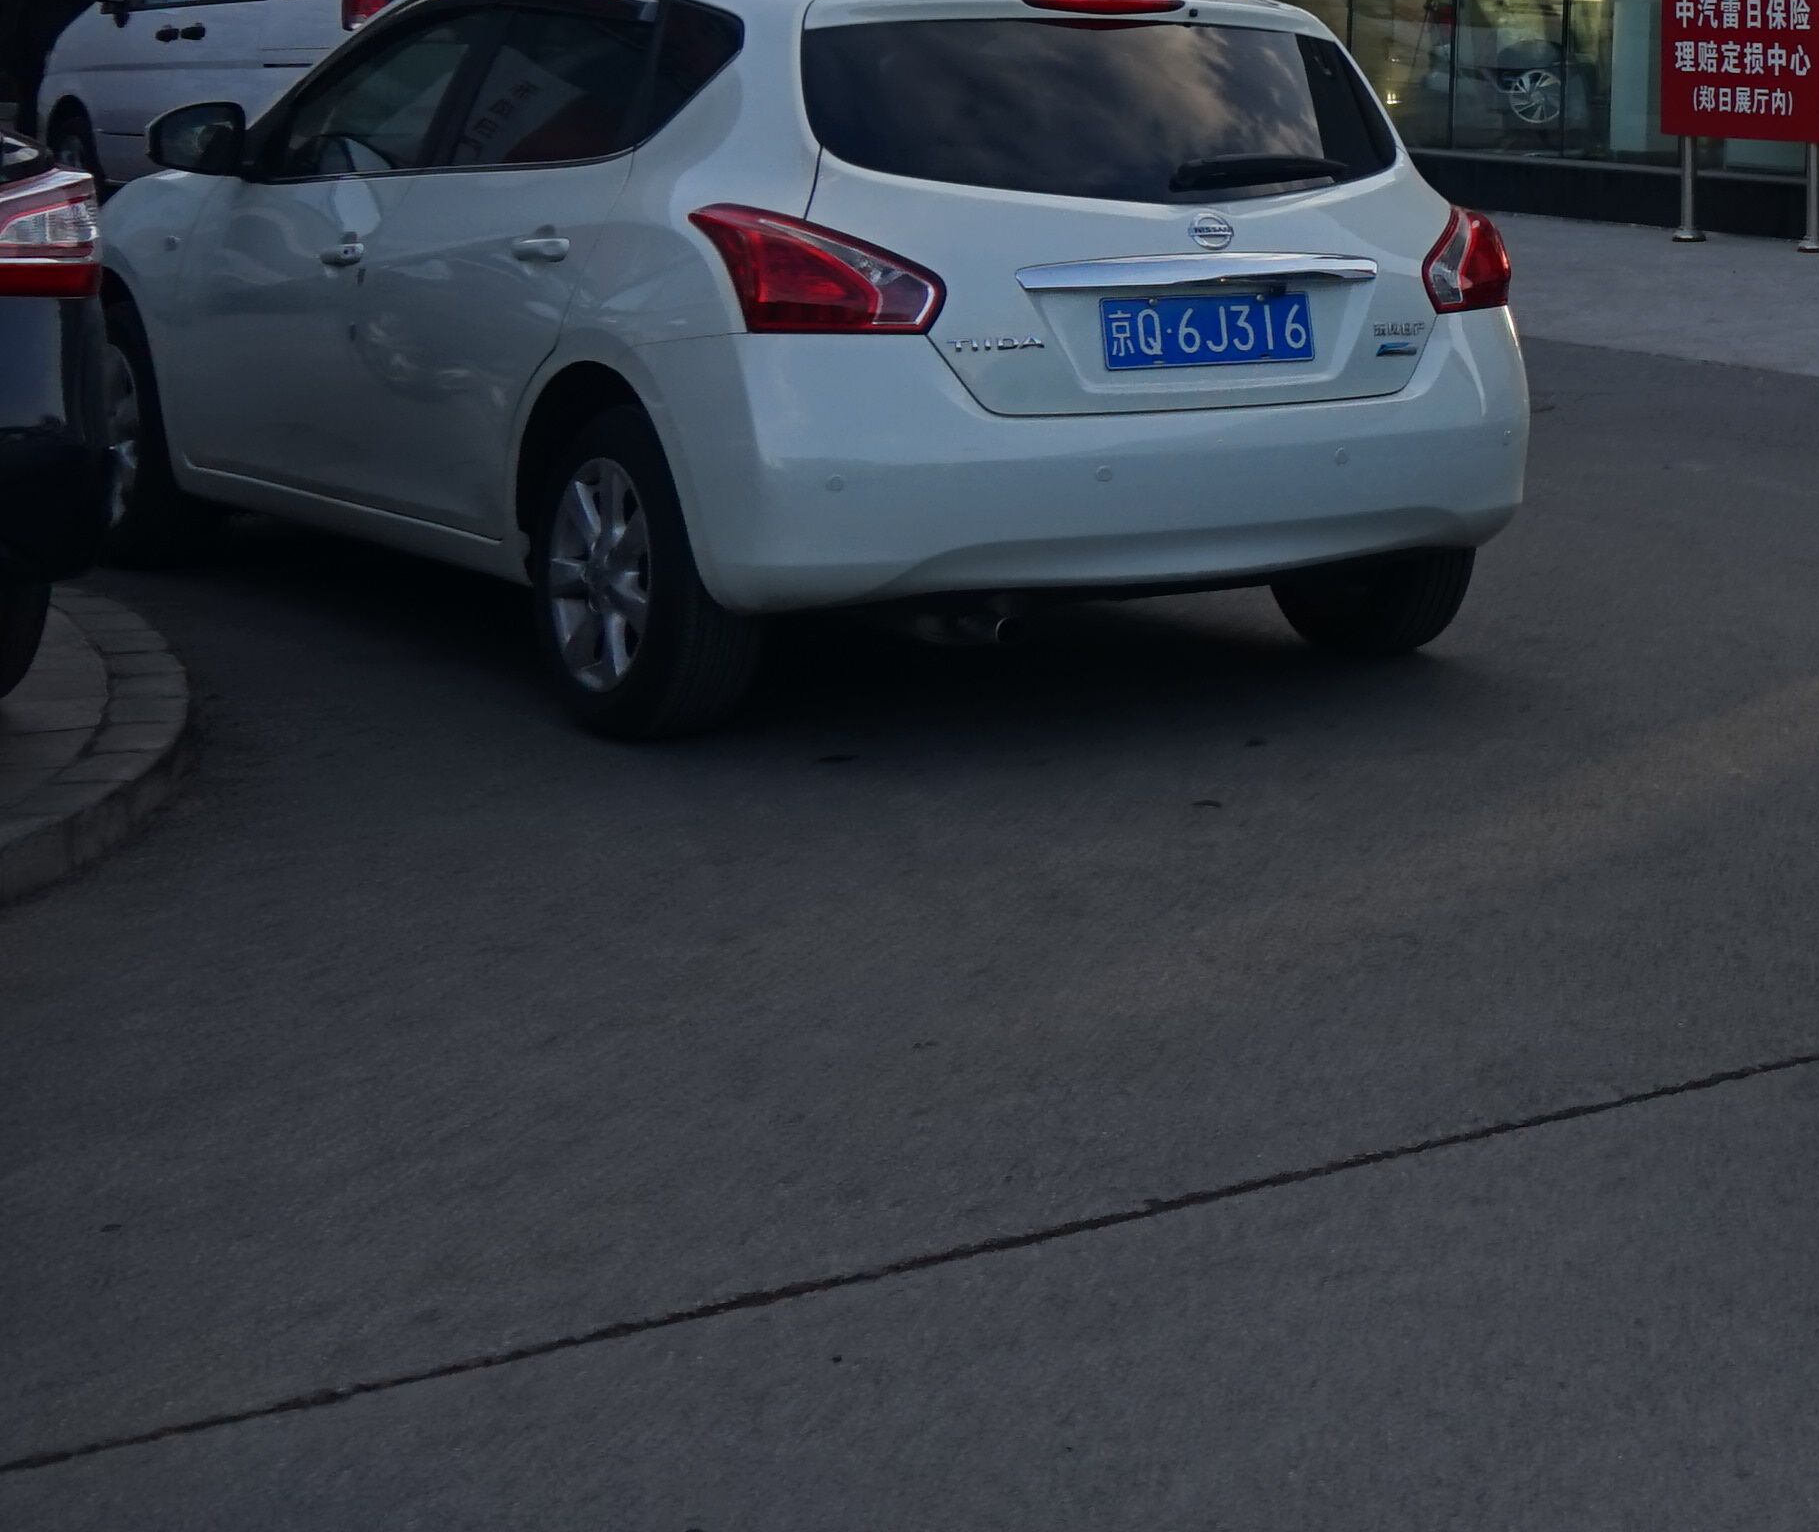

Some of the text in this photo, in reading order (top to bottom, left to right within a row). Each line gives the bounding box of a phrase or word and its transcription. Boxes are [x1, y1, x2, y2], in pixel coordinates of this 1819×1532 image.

[1674, 40, 1811, 76] 理赔定损中心
[1194, 226, 1232, 235] NISSAN
[946, 335, 1045, 353] TIIDA
